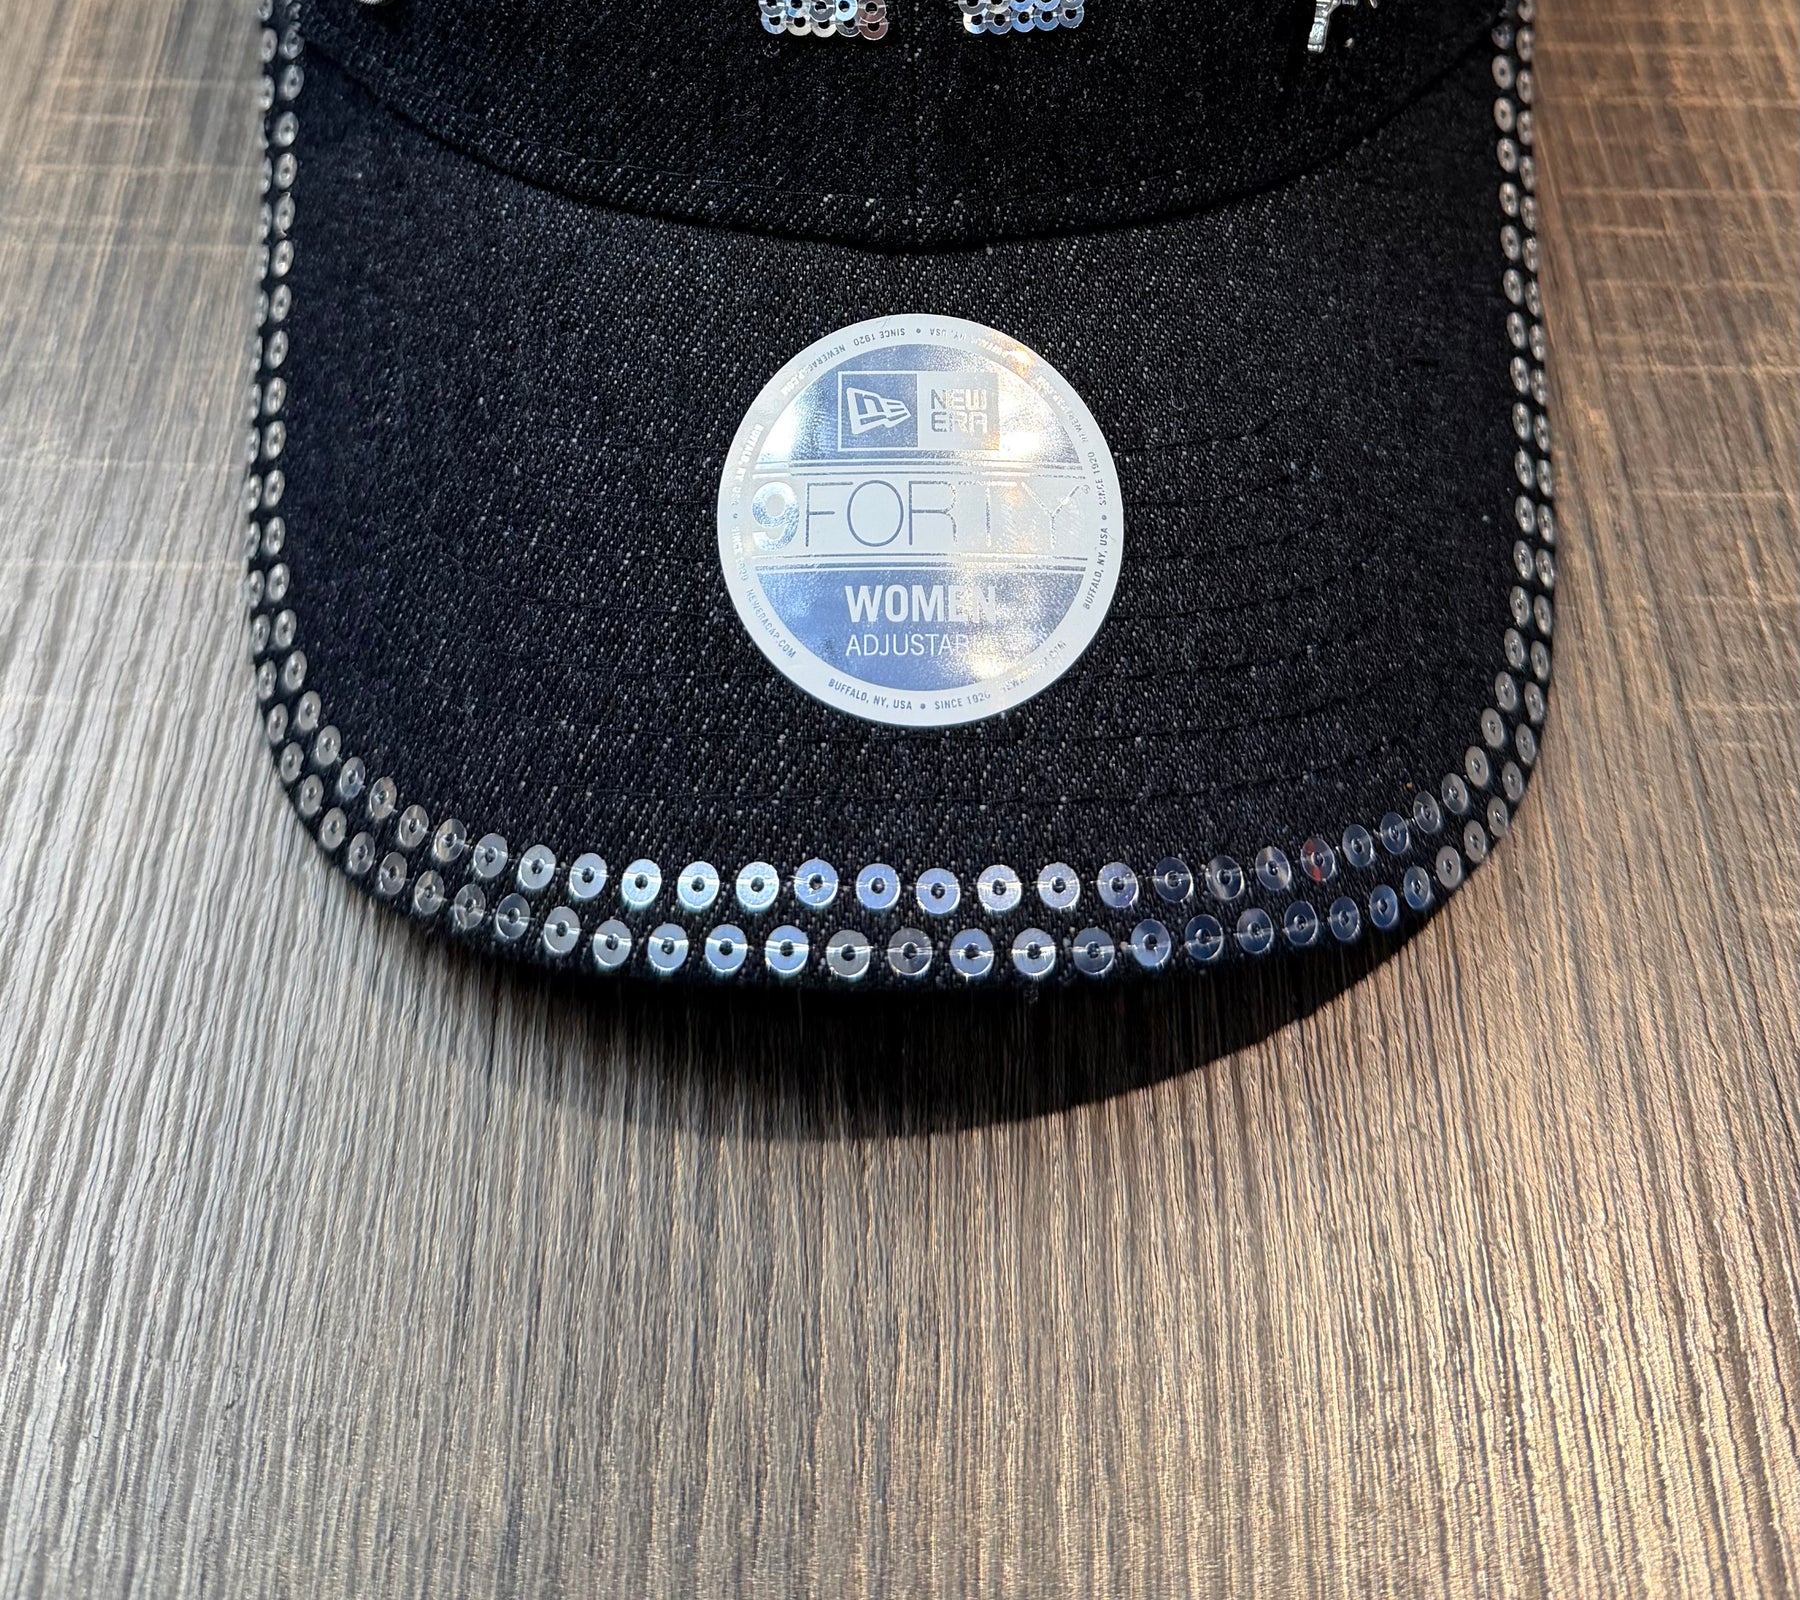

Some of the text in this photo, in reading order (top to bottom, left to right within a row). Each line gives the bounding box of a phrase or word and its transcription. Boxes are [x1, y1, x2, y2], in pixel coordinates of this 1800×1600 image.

[853, 328, 904, 346] SINCE 1920
[931, 388, 987, 410] NEW
[931, 411, 988, 435] ERA
[1087, 450, 1101, 474] 1920
[752, 479, 1082, 552] 9FORTY
[1082, 568, 1103, 609] BUFFALO,
[1099, 527, 1108, 545] USA
[845, 584, 997, 623] WOMEN
[827, 679, 912, 710] BUFFALO, NY, USA
[934, 697, 963, 710] SINCE
